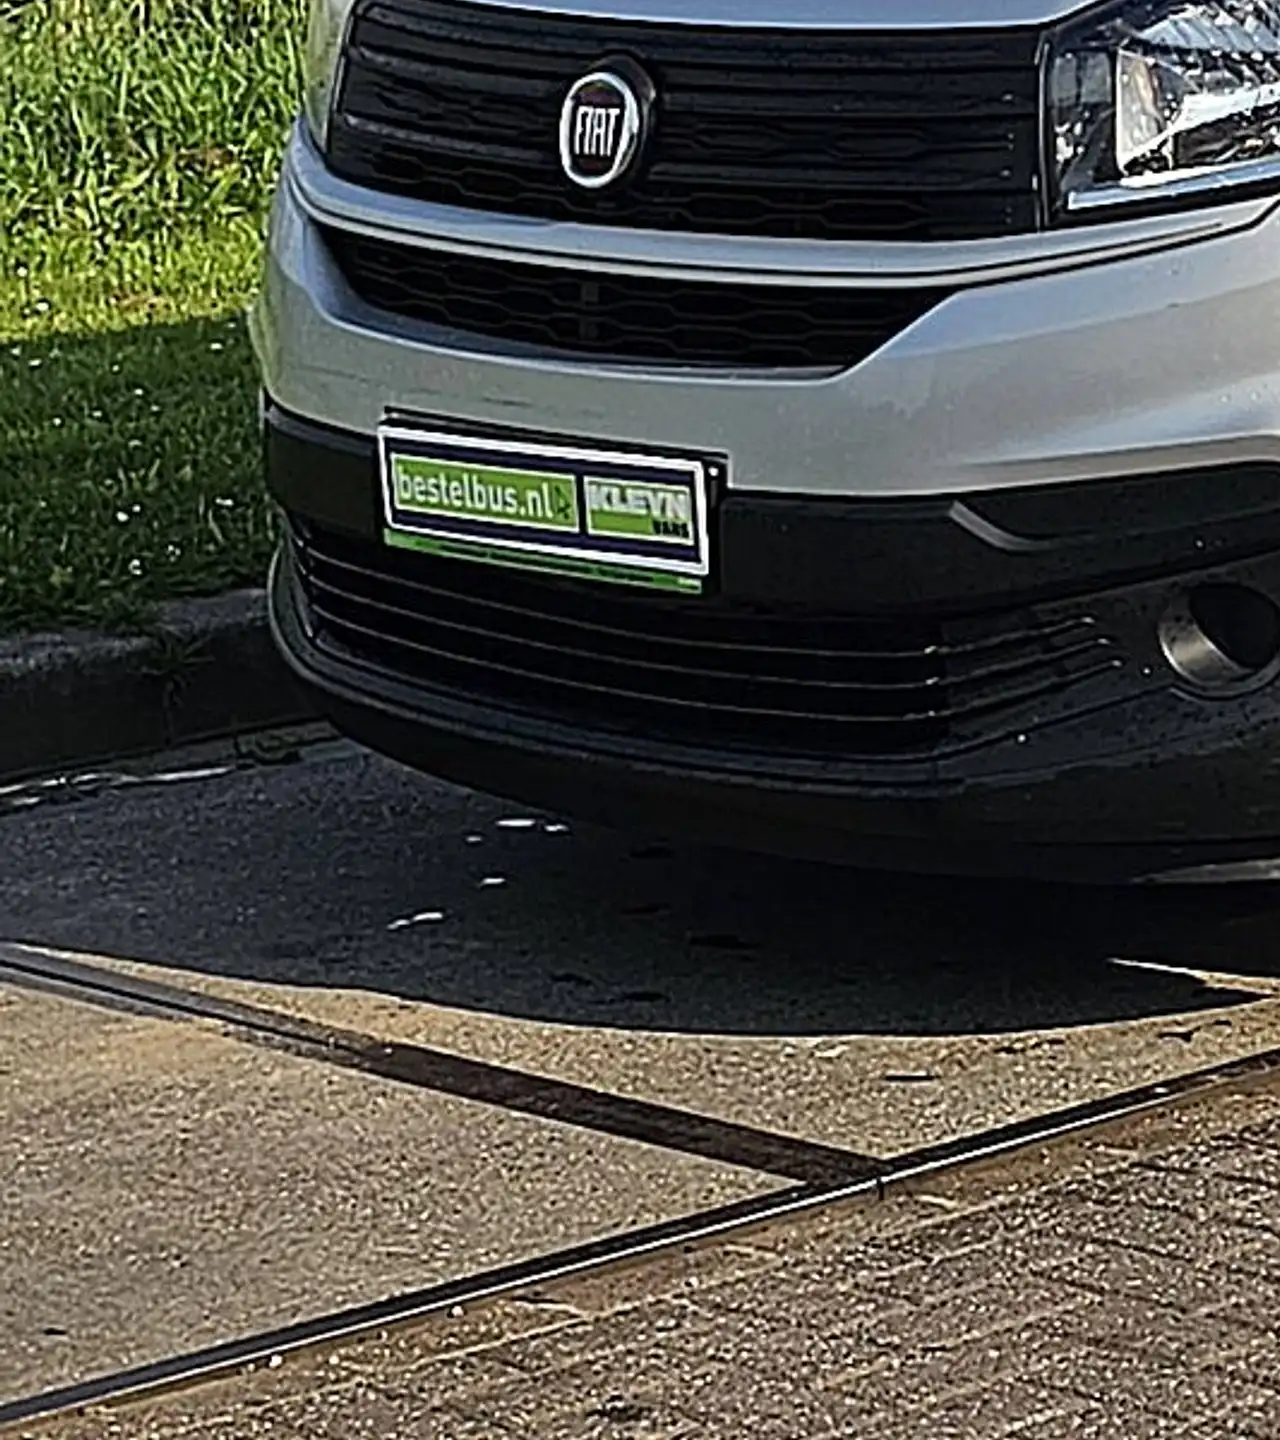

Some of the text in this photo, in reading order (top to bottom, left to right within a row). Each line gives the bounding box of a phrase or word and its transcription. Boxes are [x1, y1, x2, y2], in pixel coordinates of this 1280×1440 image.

[575, 105, 620, 156] FIAT
[397, 466, 554, 518] bestelbus.nl
[588, 484, 692, 522] KLEYN
